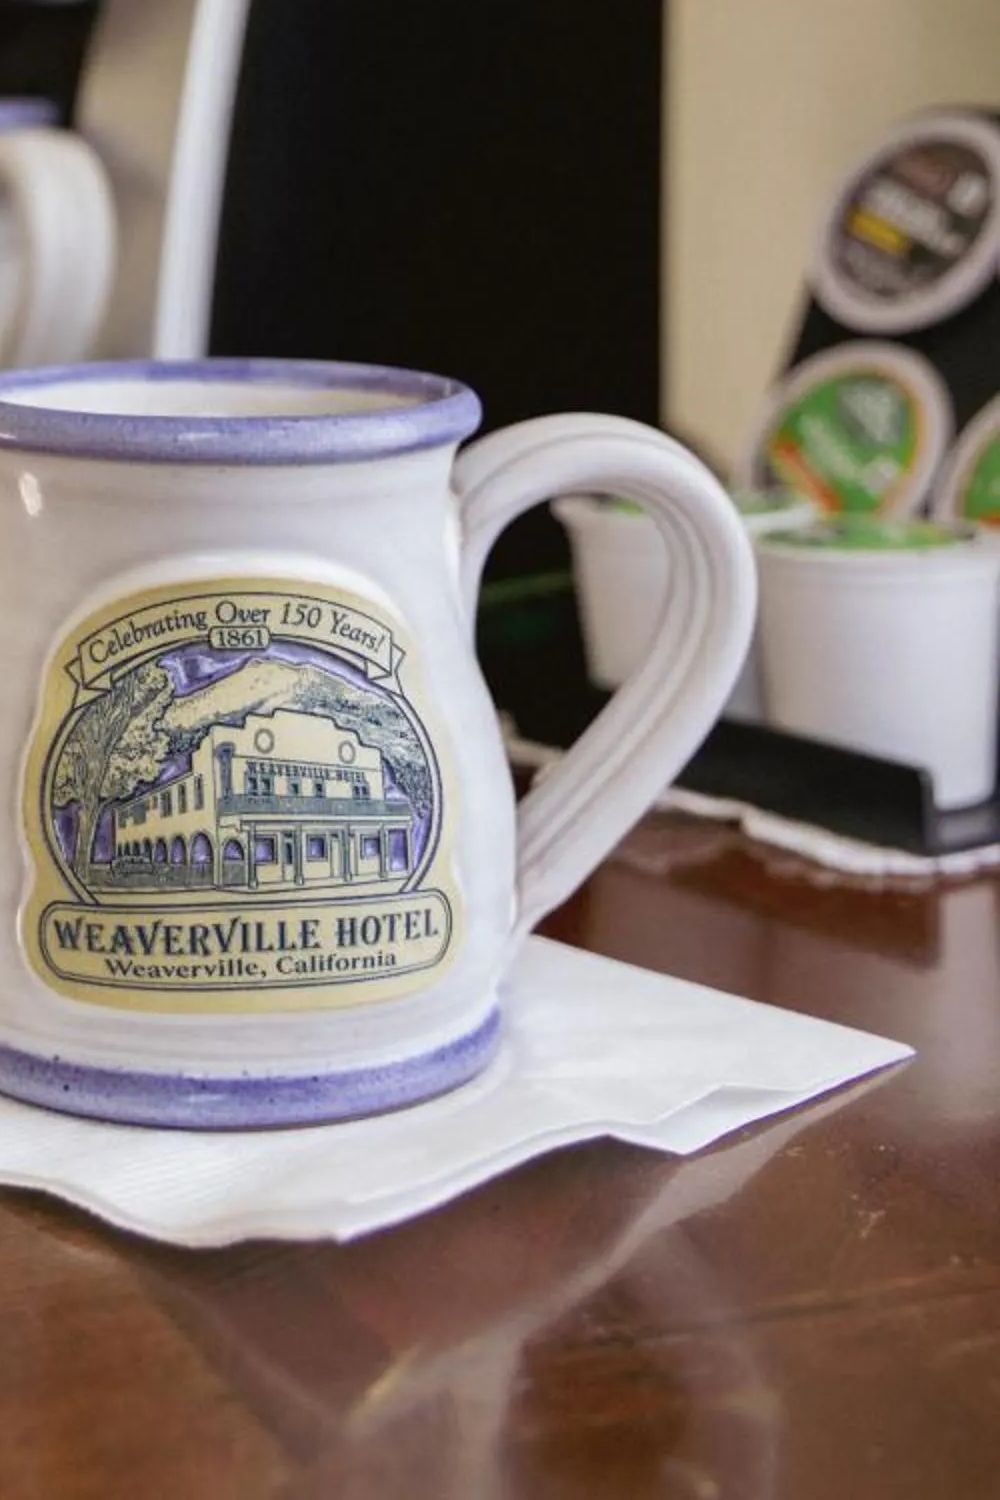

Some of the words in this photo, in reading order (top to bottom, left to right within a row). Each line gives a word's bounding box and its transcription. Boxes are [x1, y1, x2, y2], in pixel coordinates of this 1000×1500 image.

[89, 609, 208, 663] Celebrating
[215, 600, 271, 624] Over
[280, 601, 322, 629] 150
[330, 610, 386, 652] Years!
[217, 629, 264, 647] 1861
[53, 916, 321, 957] WEAVERVILLE
[335, 908, 439, 948] HOTEL
[105, 957, 267, 979] Weaverville,
[275, 949, 397, 976] California
